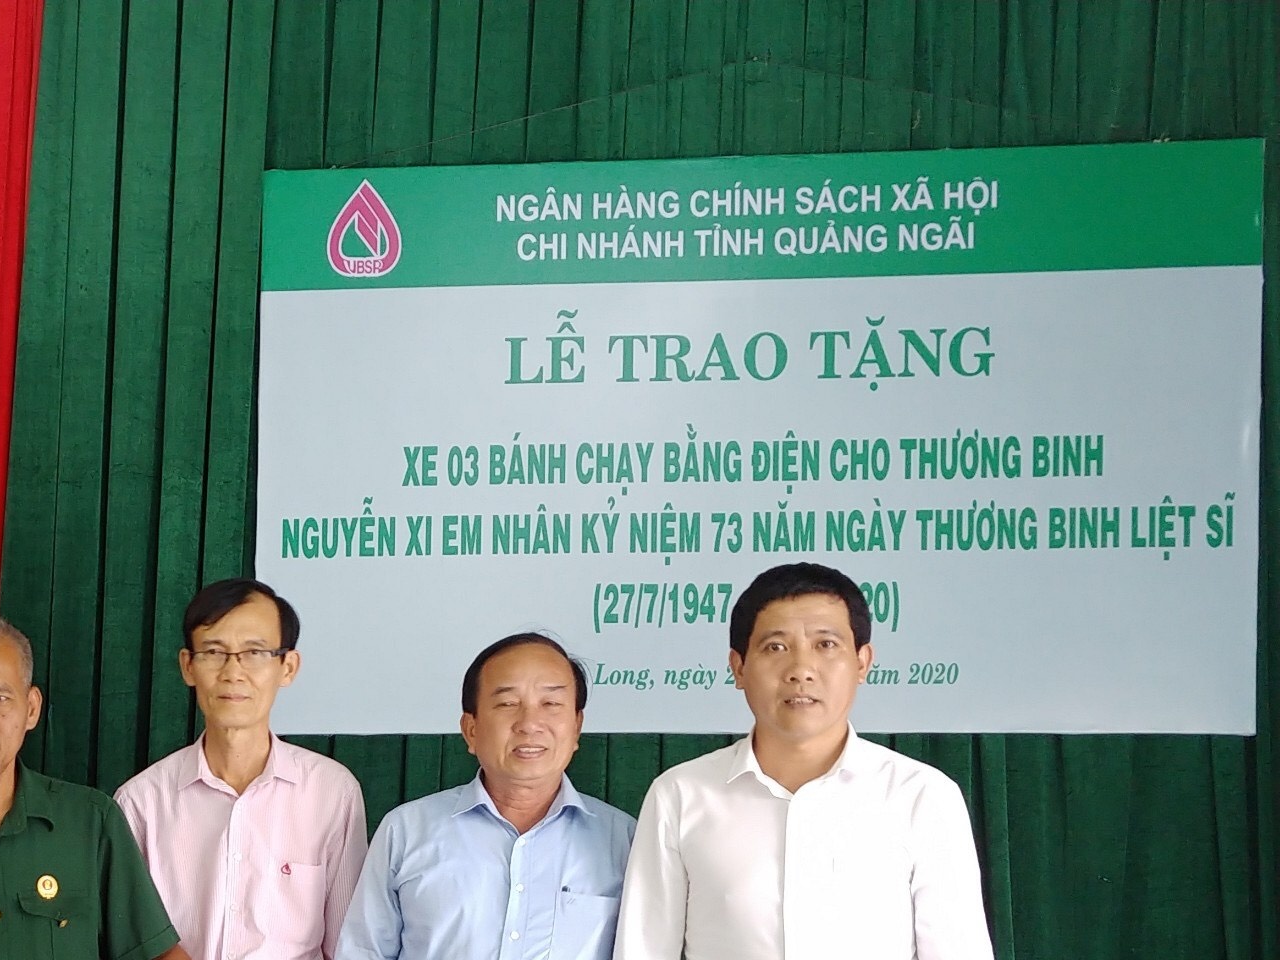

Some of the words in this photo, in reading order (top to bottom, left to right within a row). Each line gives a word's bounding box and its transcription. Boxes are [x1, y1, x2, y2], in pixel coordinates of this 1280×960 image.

[496, 188, 582, 221] NGÂN
[592, 185, 680, 220] HÀNG
[690, 181, 784, 217] CHÍNH
[795, 179, 881, 215] SÁCH
[891, 177, 934, 212] XÃ
[943, 176, 998, 216] HỘI
[517, 232, 567, 261] CHI
[577, 225, 685, 259] NHÁNH
[693, 223, 764, 257] TỈNH
[774, 220, 888, 257] QUẢNG
[898, 216, 975, 252] NGÃI
[504, 309, 586, 386] LỄ
[608, 331, 788, 383] TRAO
[809, 315, 996, 392] TẶNG
[402, 445, 438, 488] XE
[447, 445, 480, 486] 03
[489, 432, 566, 485] BÁNH
[576, 442, 655, 496] CHẠY
[663, 423, 742, 483] BẰNG
[751, 430, 820, 495] ĐIỆN
[829, 437, 890, 482] CHO
[900, 428, 1021, 480] THƯƠNG
[1032, 434, 1104, 478] BINH
[281, 496, 396, 559] NGUYỄN
[405, 515, 432, 557] XI
[442, 514, 483, 556] EM
[492, 503, 571, 556] NHÂN
[581, 496, 620, 554] KỶ
[629, 502, 701, 566] NIỆM
[711, 512, 743, 554] 73
[752, 501, 816, 553] NĂM
[825, 497, 907, 552] NGÀY
[916, 499, 1038, 551] THƯƠNG
[1049, 506, 1120, 549] BINH
[1131, 495, 1196, 561] LIỆT
[1205, 492, 1235, 548] SĨ
[593, 583, 733, 633] (27/7/1947
[593, 663, 655, 690] Long,
[664, 663, 717, 690] ngày
[866, 664, 900, 684] ăm
[908, 662, 960, 685] 2020
